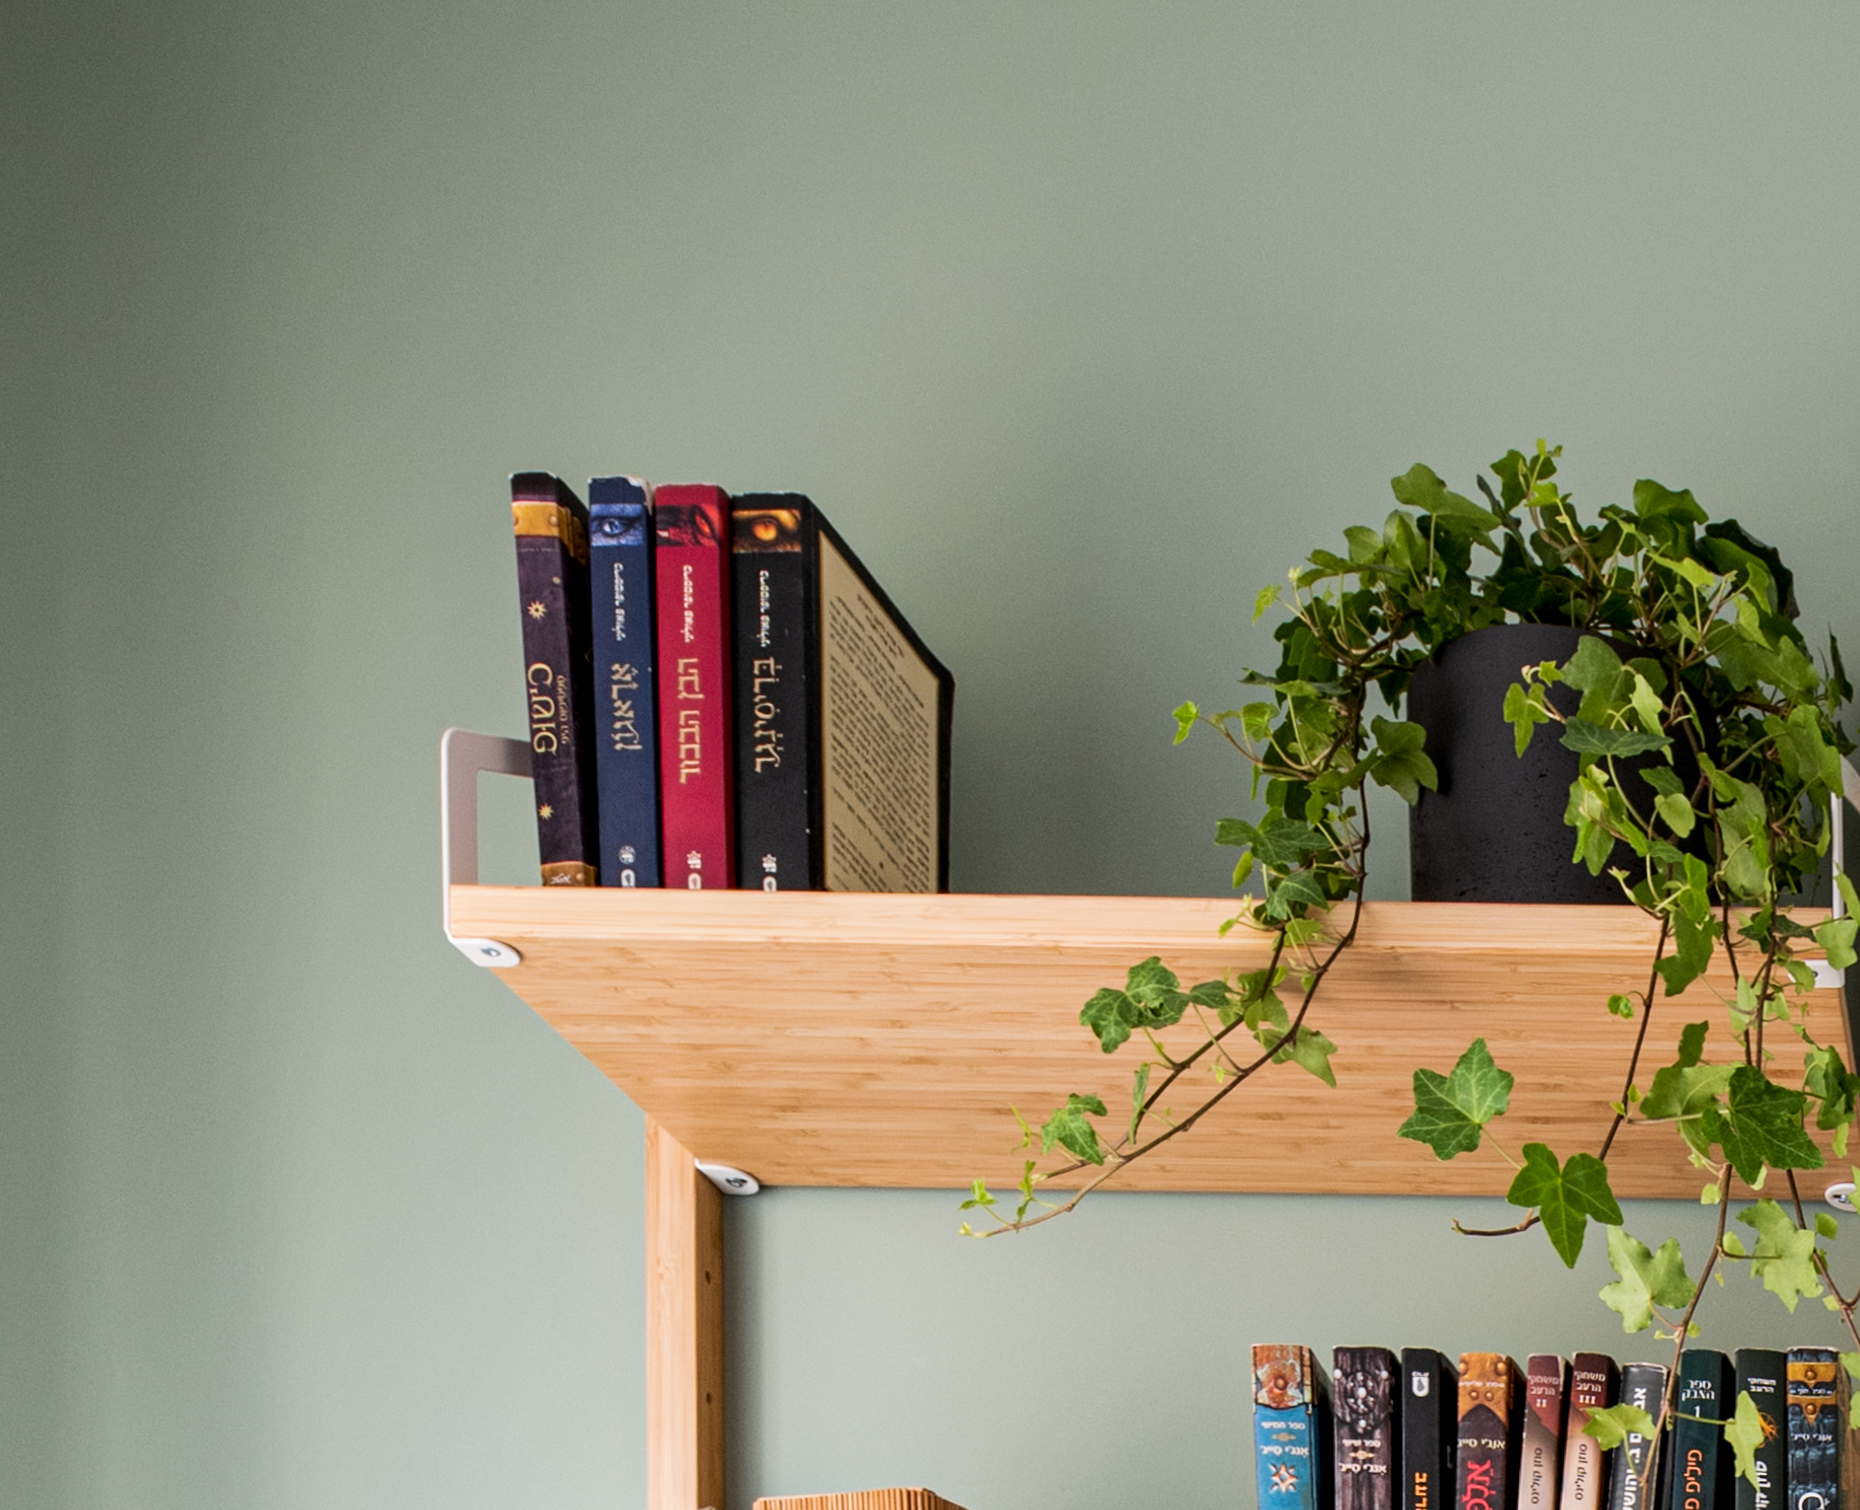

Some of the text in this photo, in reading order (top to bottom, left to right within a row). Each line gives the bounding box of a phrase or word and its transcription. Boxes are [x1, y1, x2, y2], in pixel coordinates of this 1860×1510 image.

[677, 657, 704, 699] הבן
[1528, 1374, 1560, 1386] משחקי
[1573, 1371, 1606, 1382] משחקי
[1530, 1386, 1556, 1395] הרעב
[1576, 1382, 1602, 1393] הרעב
[1687, 1379, 1712, 1390] ספר
[1579, 1395, 1596, 1405] III
[1681, 1388, 1715, 1401] האבק
[1535, 1399, 1547, 1408] II
[1628, 1386, 1647, 1445] אבם
[1693, 1405, 1700, 1418] 1
[1530, 1447, 1543, 1504] סוזן קולינס
[1574, 1443, 1588, 1501] סוזן קולינס
[1684, 1449, 1703, 1492] פיליפ
